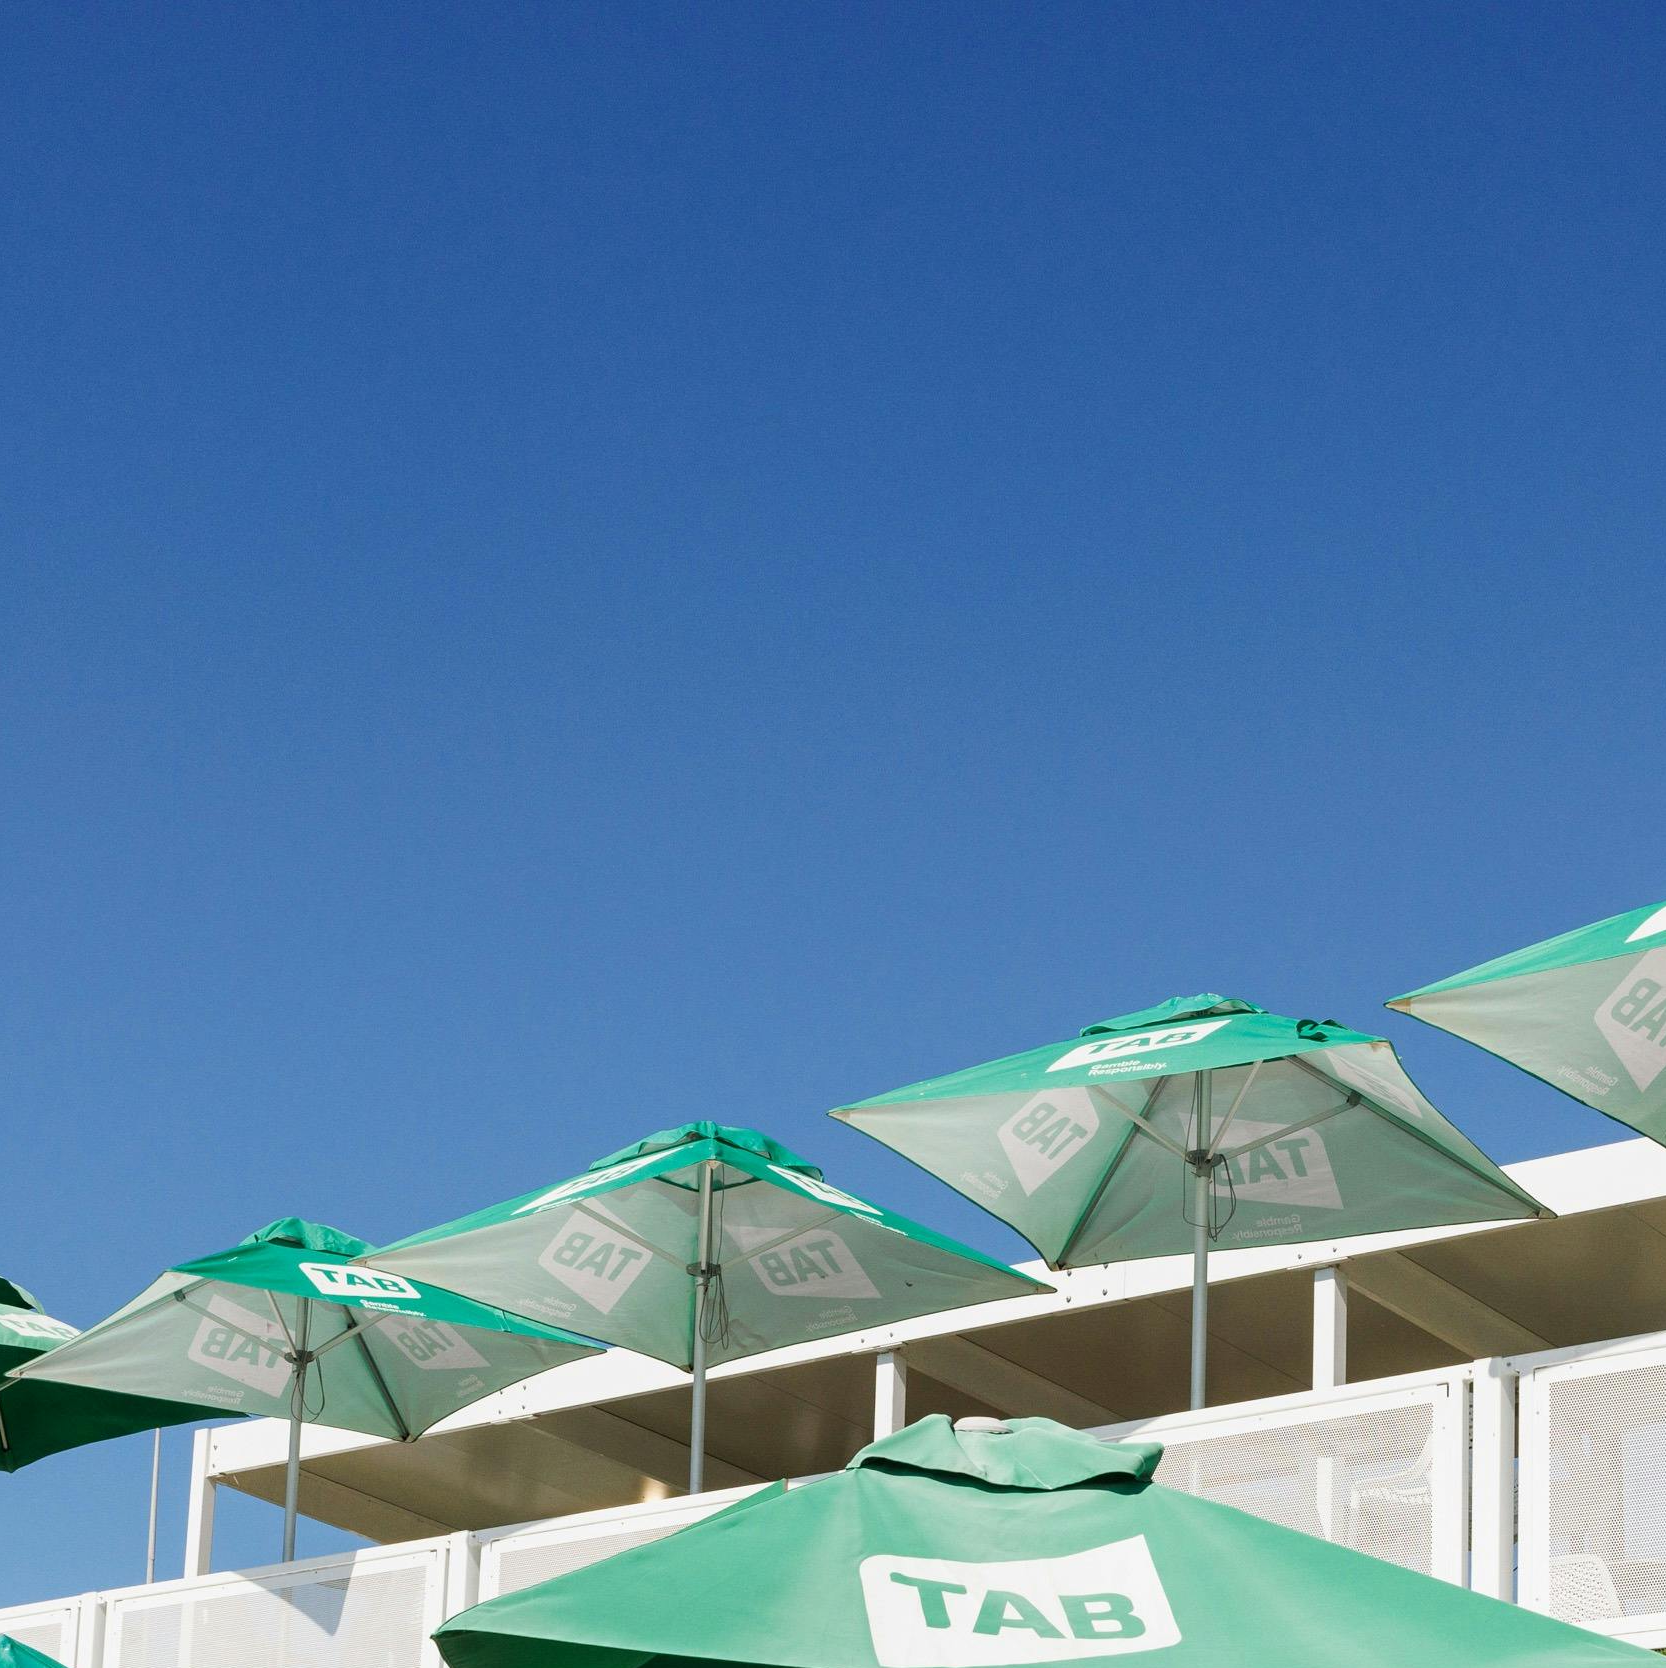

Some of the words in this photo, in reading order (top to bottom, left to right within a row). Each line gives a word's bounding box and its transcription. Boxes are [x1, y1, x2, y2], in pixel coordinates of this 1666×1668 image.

[1087, 1031, 1198, 1055] TAB
[310, 1267, 408, 1293] TAB
[889, 1571, 1146, 1640] TAB
